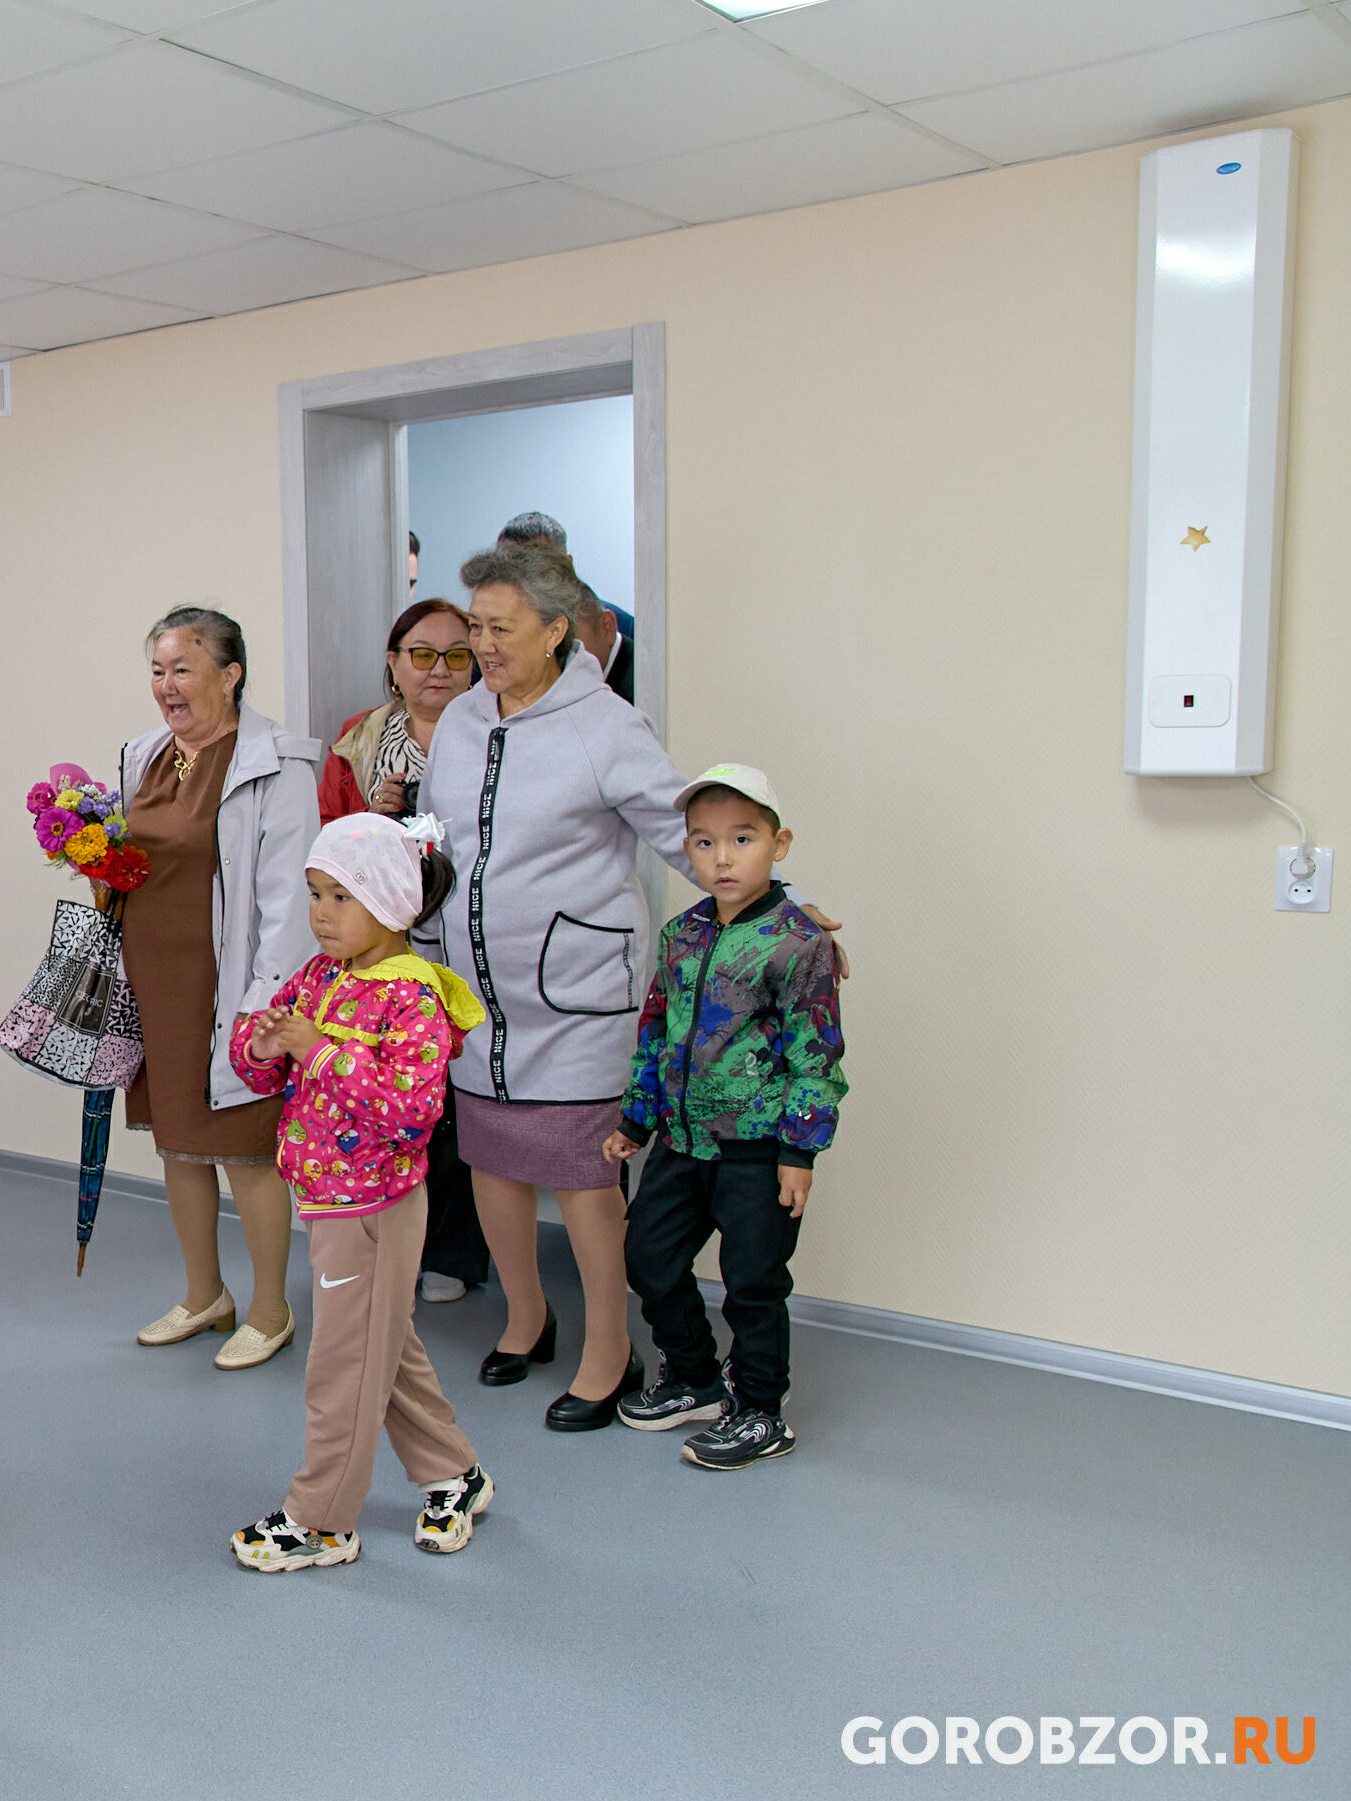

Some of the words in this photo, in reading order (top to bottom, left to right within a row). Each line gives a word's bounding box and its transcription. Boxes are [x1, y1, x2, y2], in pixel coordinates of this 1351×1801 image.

[486, 762, 498, 786] NICE
[481, 793, 491, 818] NICE
[482, 825, 490, 850] NICE
[473, 857, 486, 880] NICE
[472, 888, 480, 911] NICE
[472, 919, 480, 941] NICE
[476, 948, 485, 970] NICE
[481, 978, 493, 999] NICE
[489, 1003, 503, 1023] NICE
[494, 1029, 503, 1052] NICE
[493, 1060, 502, 1082] NICE
